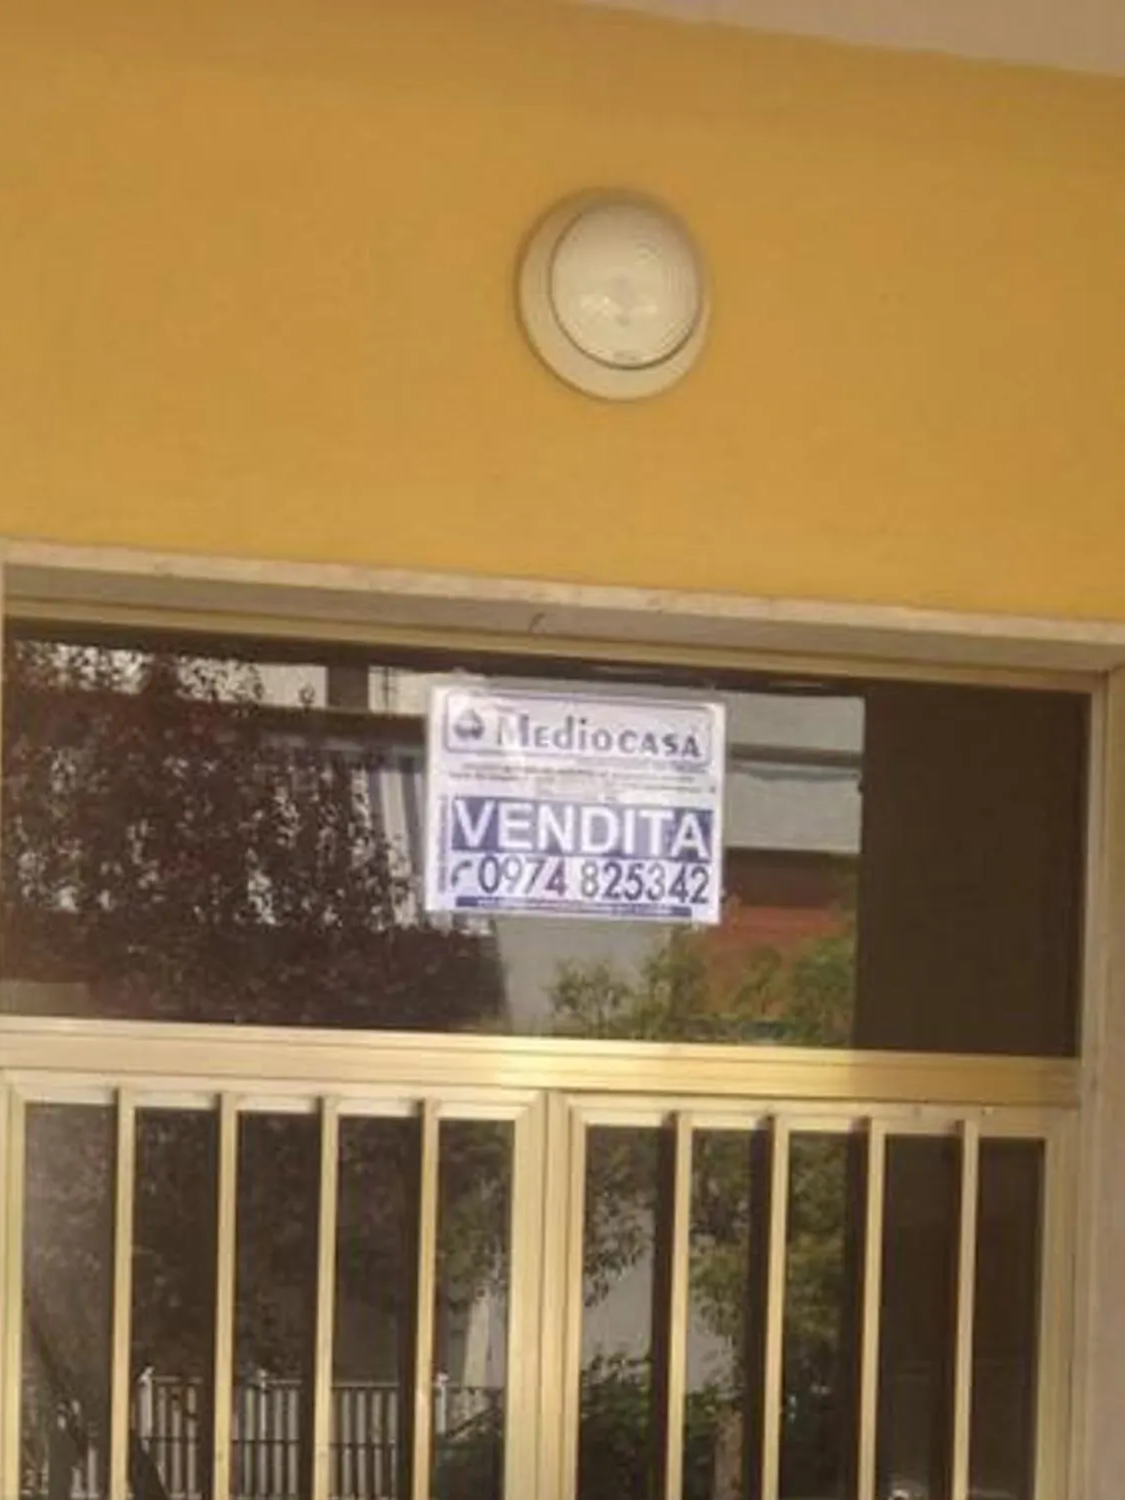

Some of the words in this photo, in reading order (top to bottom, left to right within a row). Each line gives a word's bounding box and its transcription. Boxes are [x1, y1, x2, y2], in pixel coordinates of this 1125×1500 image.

[454, 800, 710, 857] VENDITA
[478, 855, 567, 896] 0974
[580, 861, 709, 905] 825342
